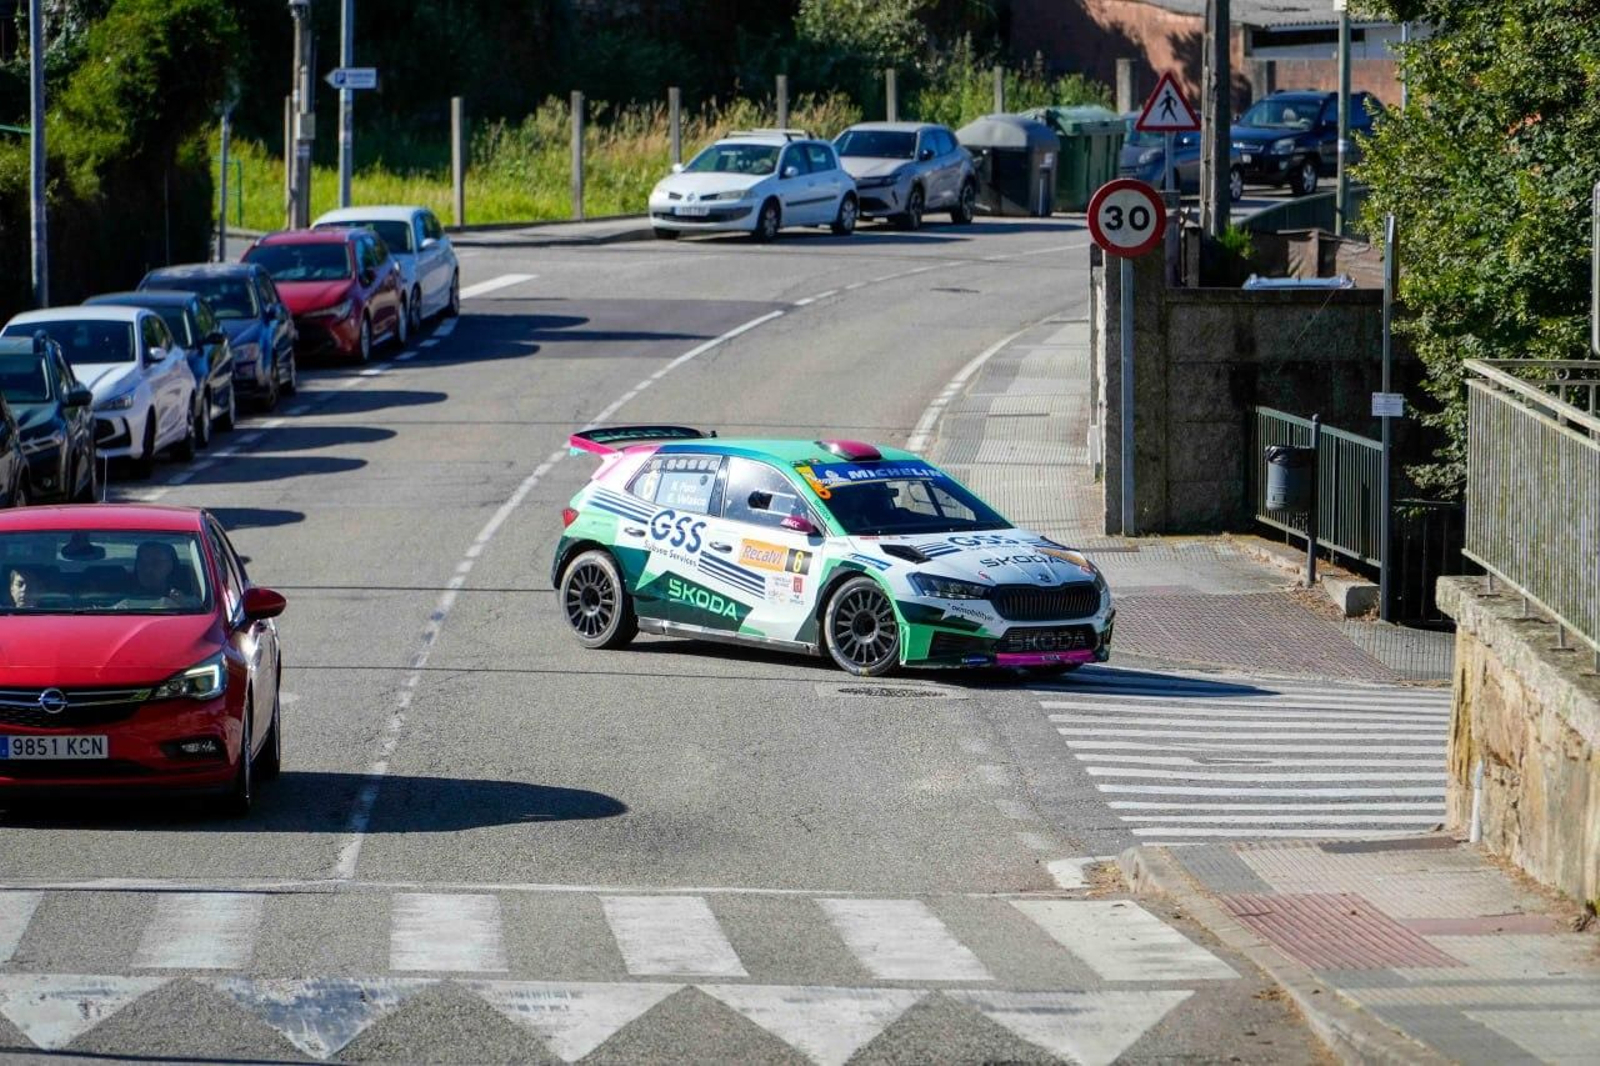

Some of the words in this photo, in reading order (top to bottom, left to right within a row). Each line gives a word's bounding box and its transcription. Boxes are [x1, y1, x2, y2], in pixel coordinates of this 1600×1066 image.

[1105, 205, 1150, 231] 30
[848, 468, 943, 479] MICHELIN
[651, 509, 706, 553] GSS
[670, 549, 697, 567] Services
[743, 545, 783, 565] Recalvi
[793, 551, 804, 573] 6
[12, 738, 57, 756] 9851
[67, 737, 103, 755] KCN
